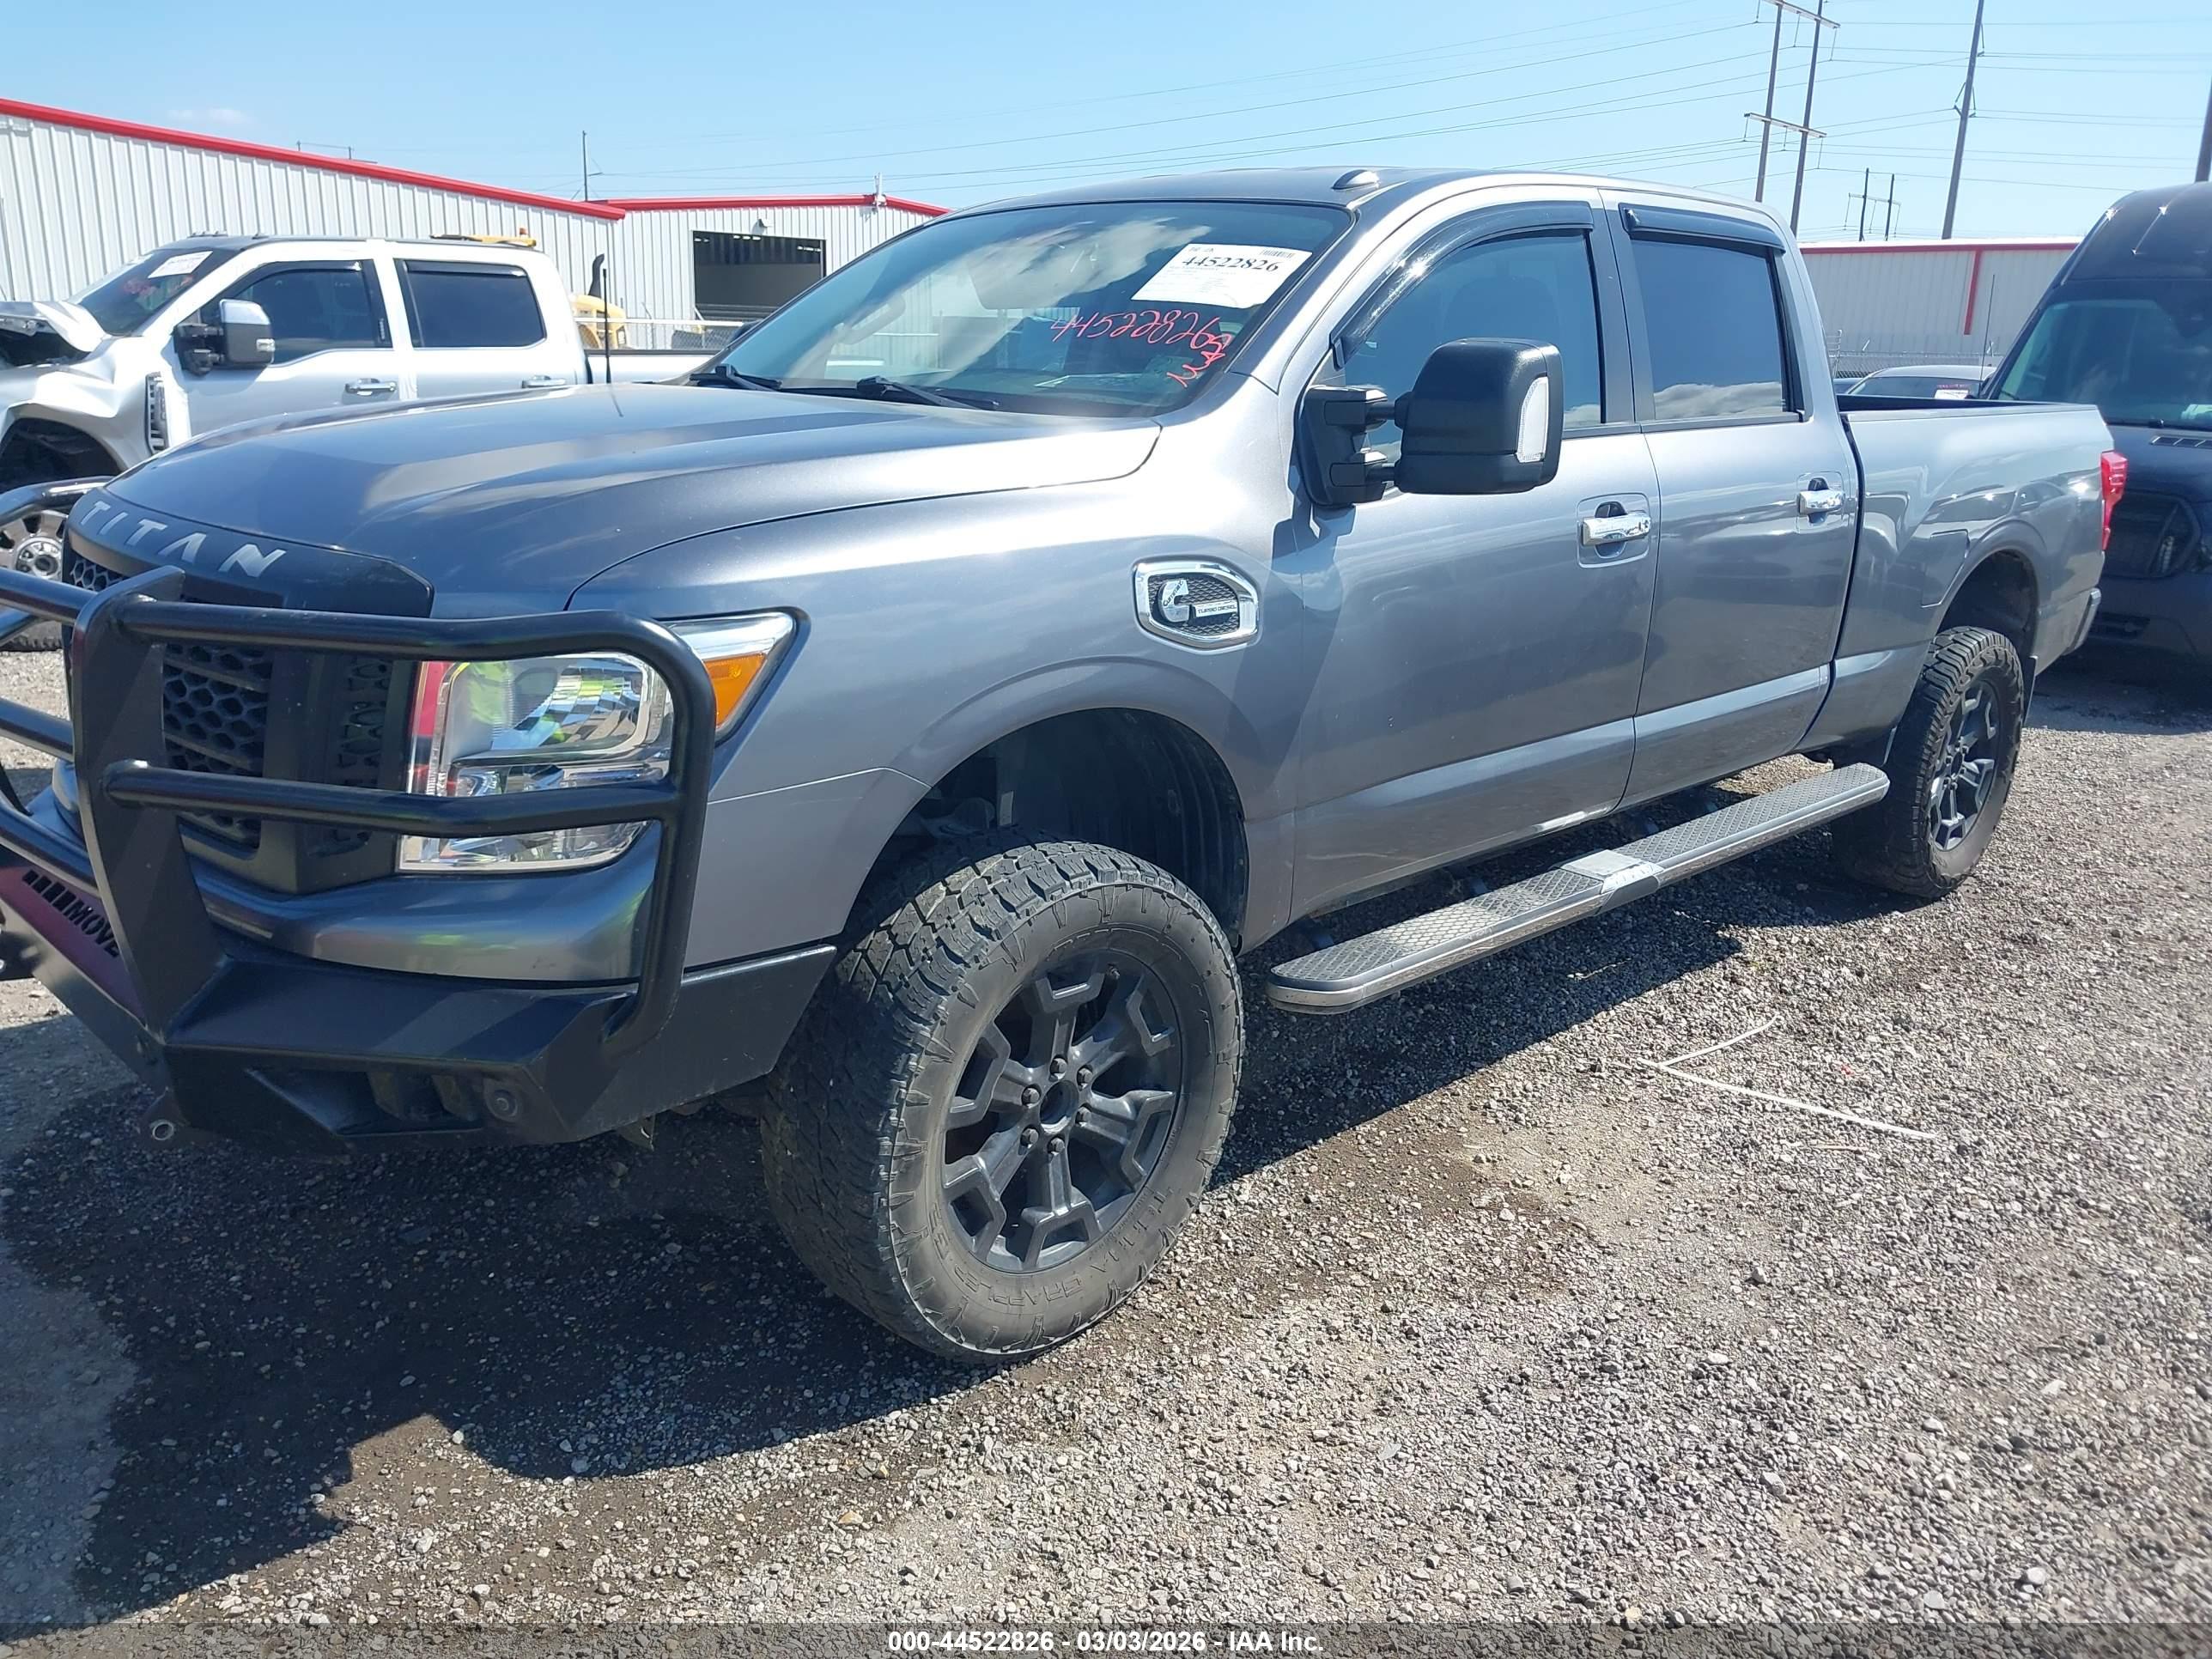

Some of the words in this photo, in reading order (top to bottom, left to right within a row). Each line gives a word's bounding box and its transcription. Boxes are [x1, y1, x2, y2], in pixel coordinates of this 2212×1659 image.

[1182, 256, 1283, 272] 44522826
[1051, 309, 1220, 350] 44522826
[81, 500, 287, 578] TITAN
